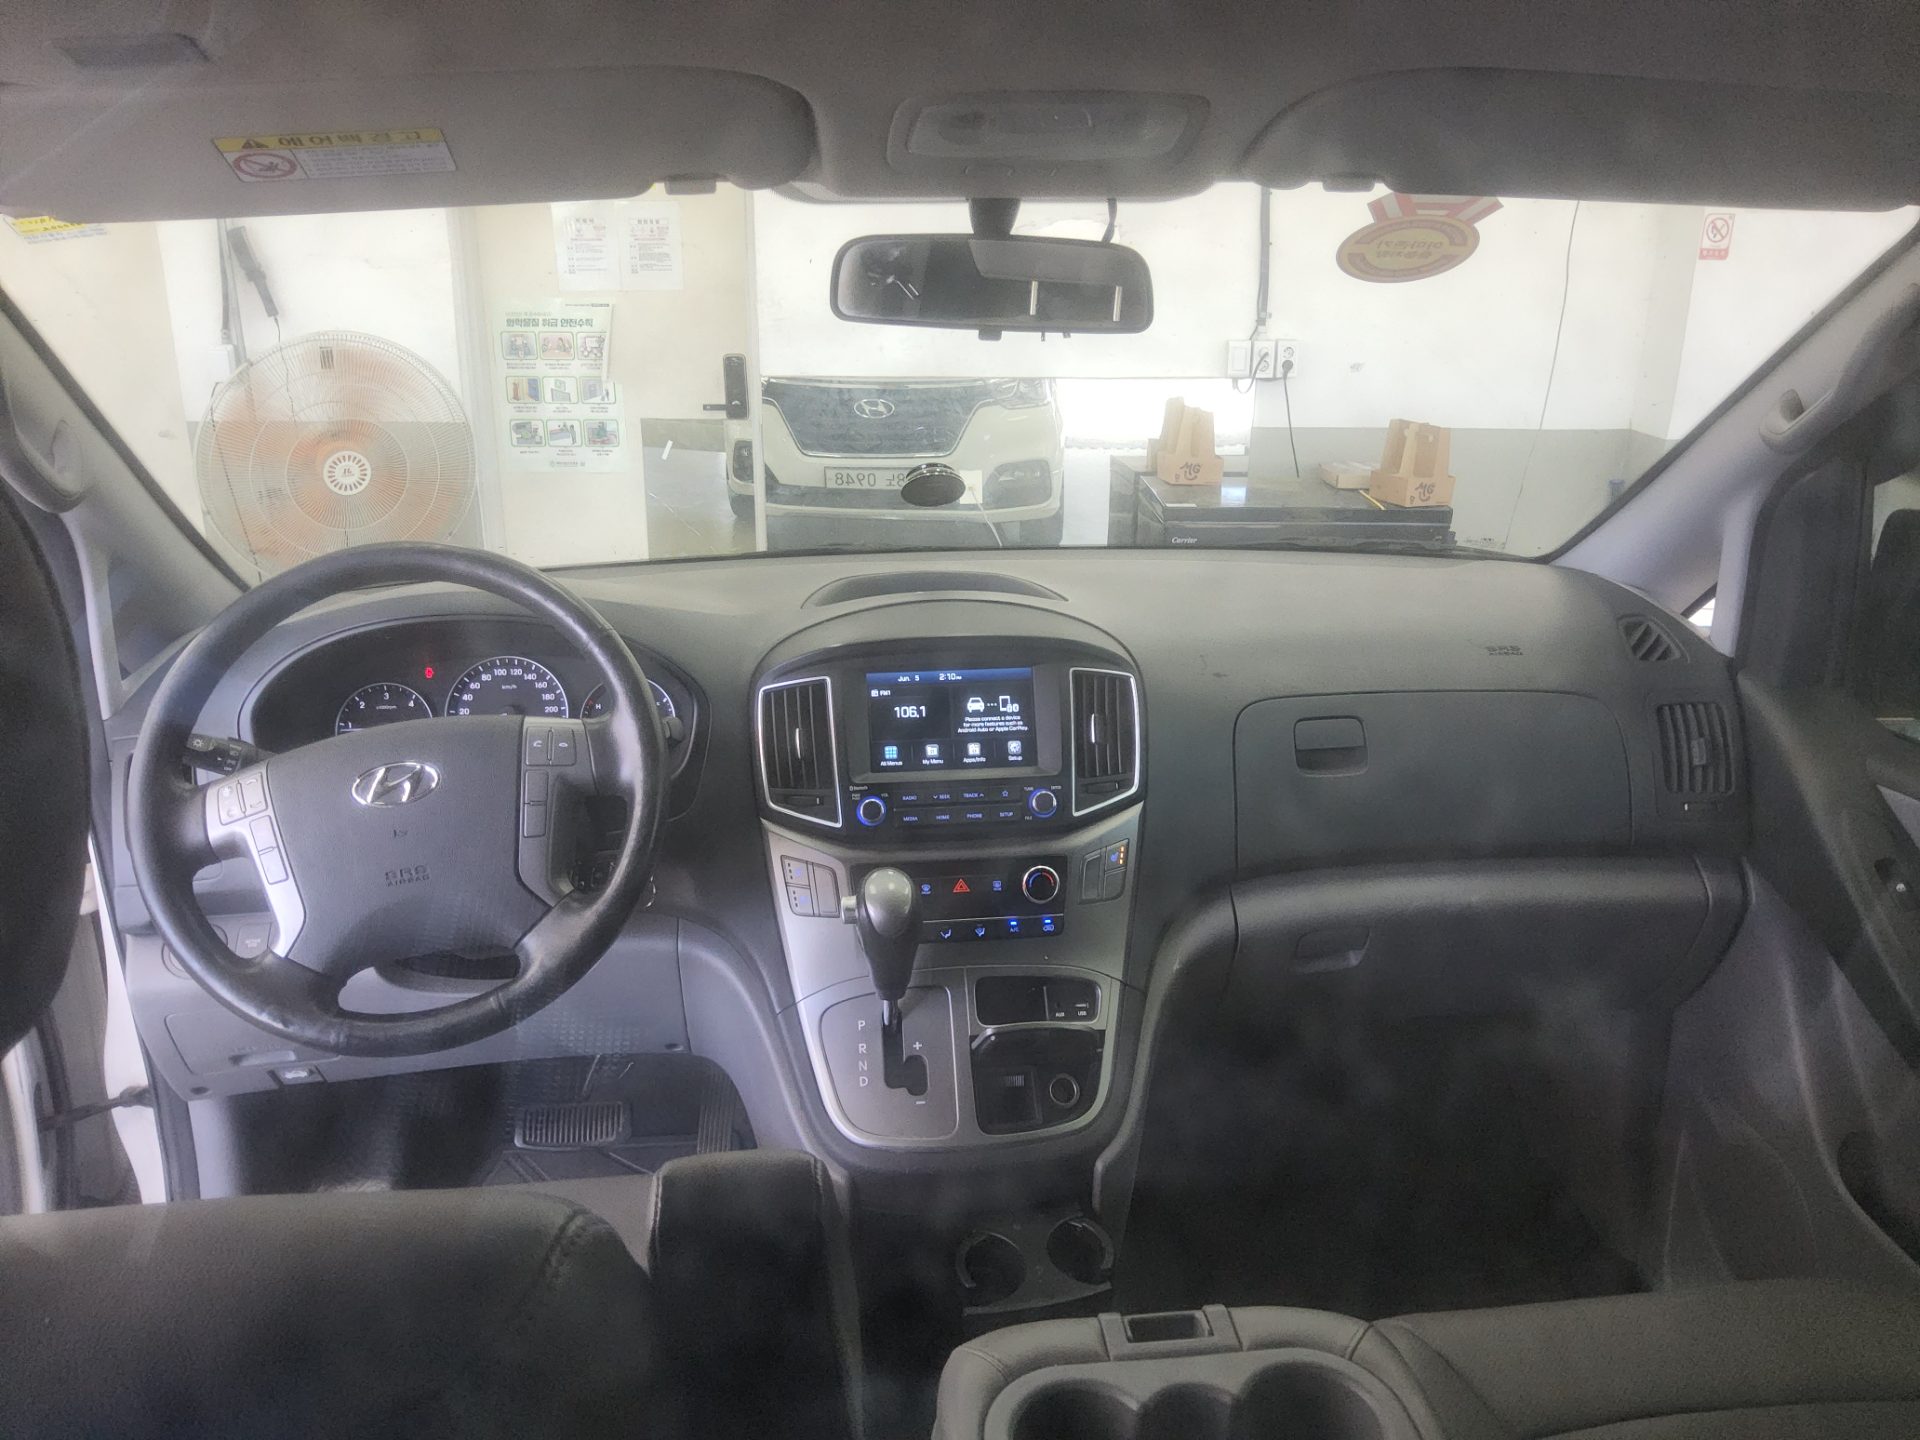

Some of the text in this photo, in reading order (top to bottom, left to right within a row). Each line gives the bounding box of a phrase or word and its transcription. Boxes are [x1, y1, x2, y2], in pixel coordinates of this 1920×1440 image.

[560, 318, 594, 328] 안전수칙
[1172, 536, 1198, 544] Carrier
[384, 692, 389, 700] 3
[359, 701, 365, 709] 2
[894, 705, 926, 718] 106.1
[858, 1020, 869, 1087] P R N D
